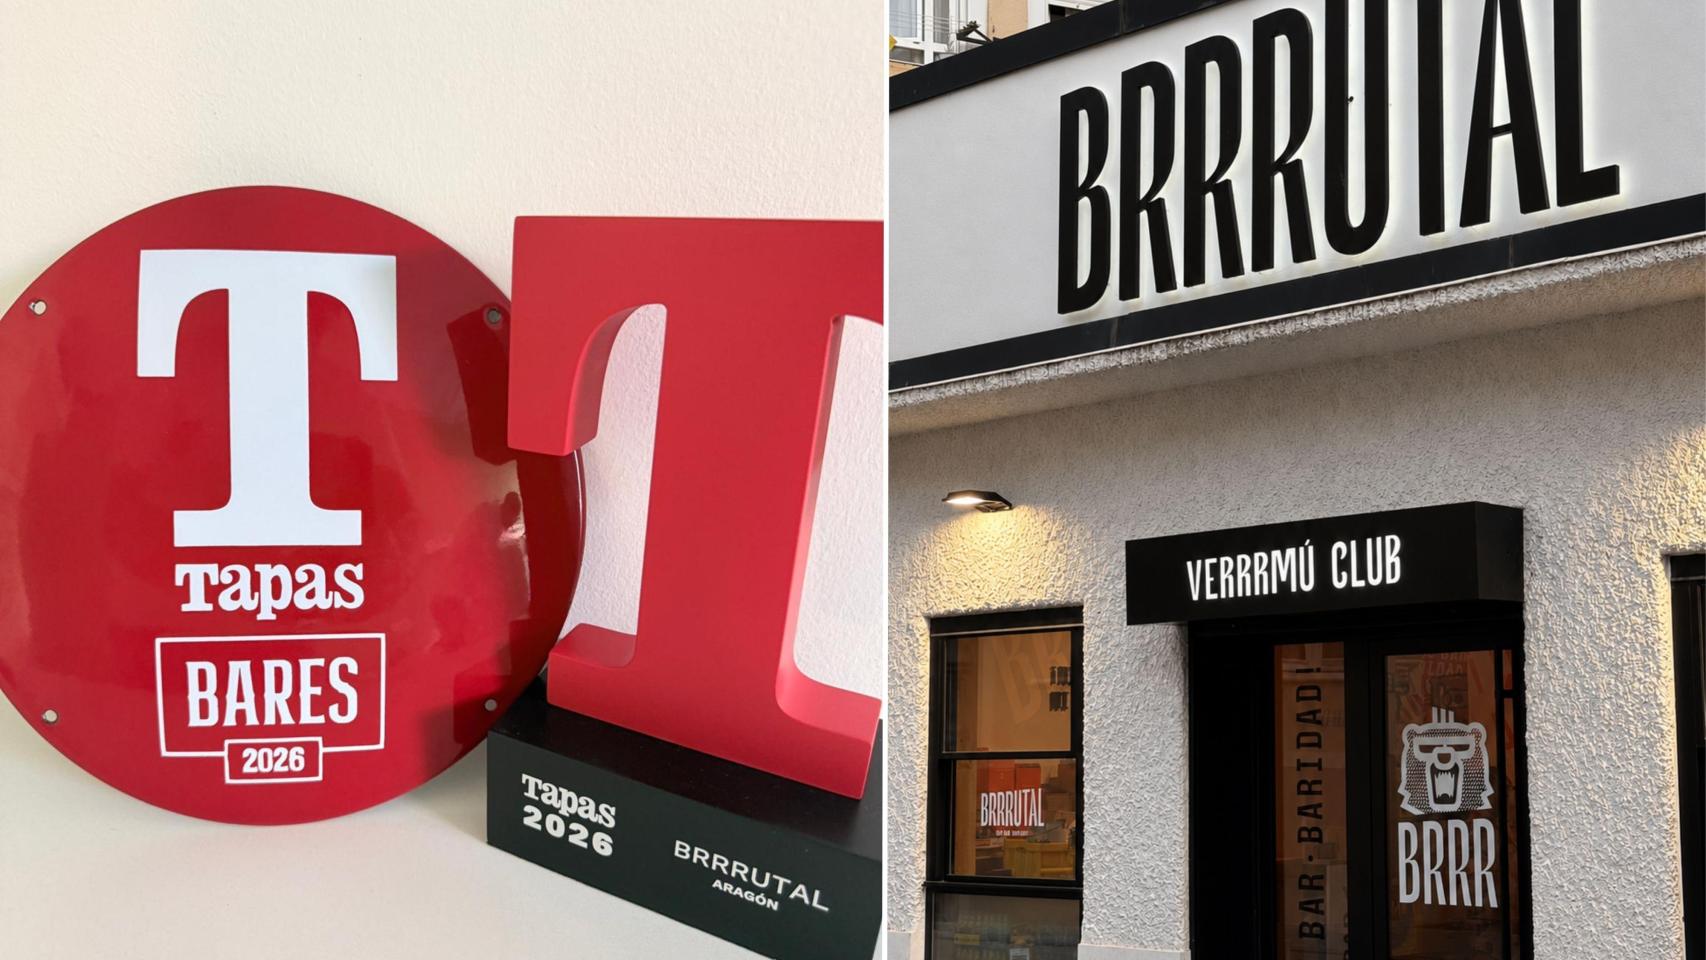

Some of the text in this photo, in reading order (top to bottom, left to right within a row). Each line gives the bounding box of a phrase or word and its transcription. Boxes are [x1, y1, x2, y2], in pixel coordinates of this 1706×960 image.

[1057, 0, 1621, 315] BRRRUTAL
[137, 249, 398, 548] T
[174, 562, 364, 620] Tapas
[1186, 534, 1401, 601] VERRRMÚ CLUB
[185, 656, 359, 727] BARES
[242, 746, 306, 774] 2026
[522, 773, 616, 828] Tapas
[523, 804, 613, 857] 2026
[980, 788, 1045, 827] BRRRUTAL
[674, 839, 830, 912] BRRRUTAL
[1397, 818, 1498, 908] BRRR
[712, 879, 779, 911] ARAGÓN
